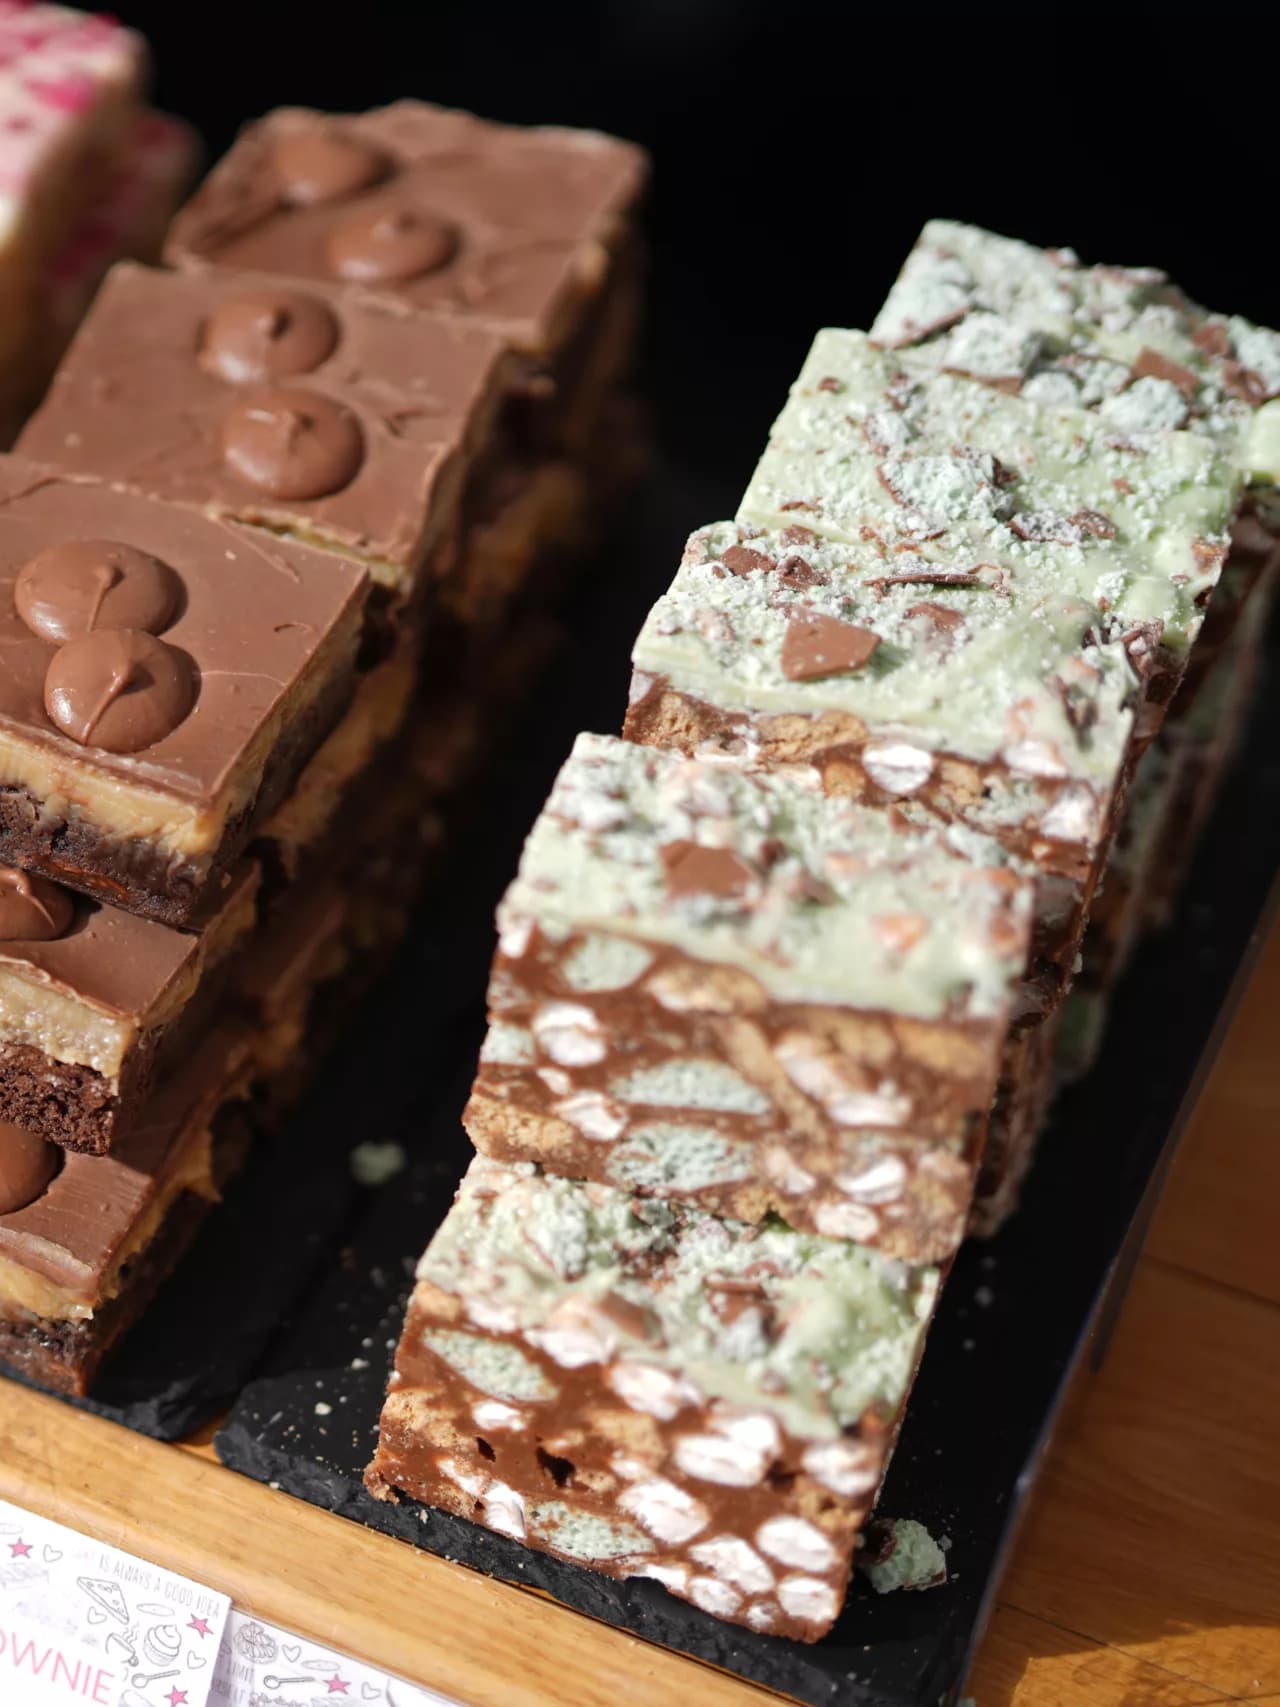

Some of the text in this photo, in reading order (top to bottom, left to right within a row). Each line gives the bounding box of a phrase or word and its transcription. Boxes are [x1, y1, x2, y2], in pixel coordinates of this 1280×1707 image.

[99, 1553, 111, 1574] IS
[113, 1561, 151, 1592] ALWAYS
[164, 1582, 194, 1607] GOOD
[196, 1595, 220, 1619] IDEA
